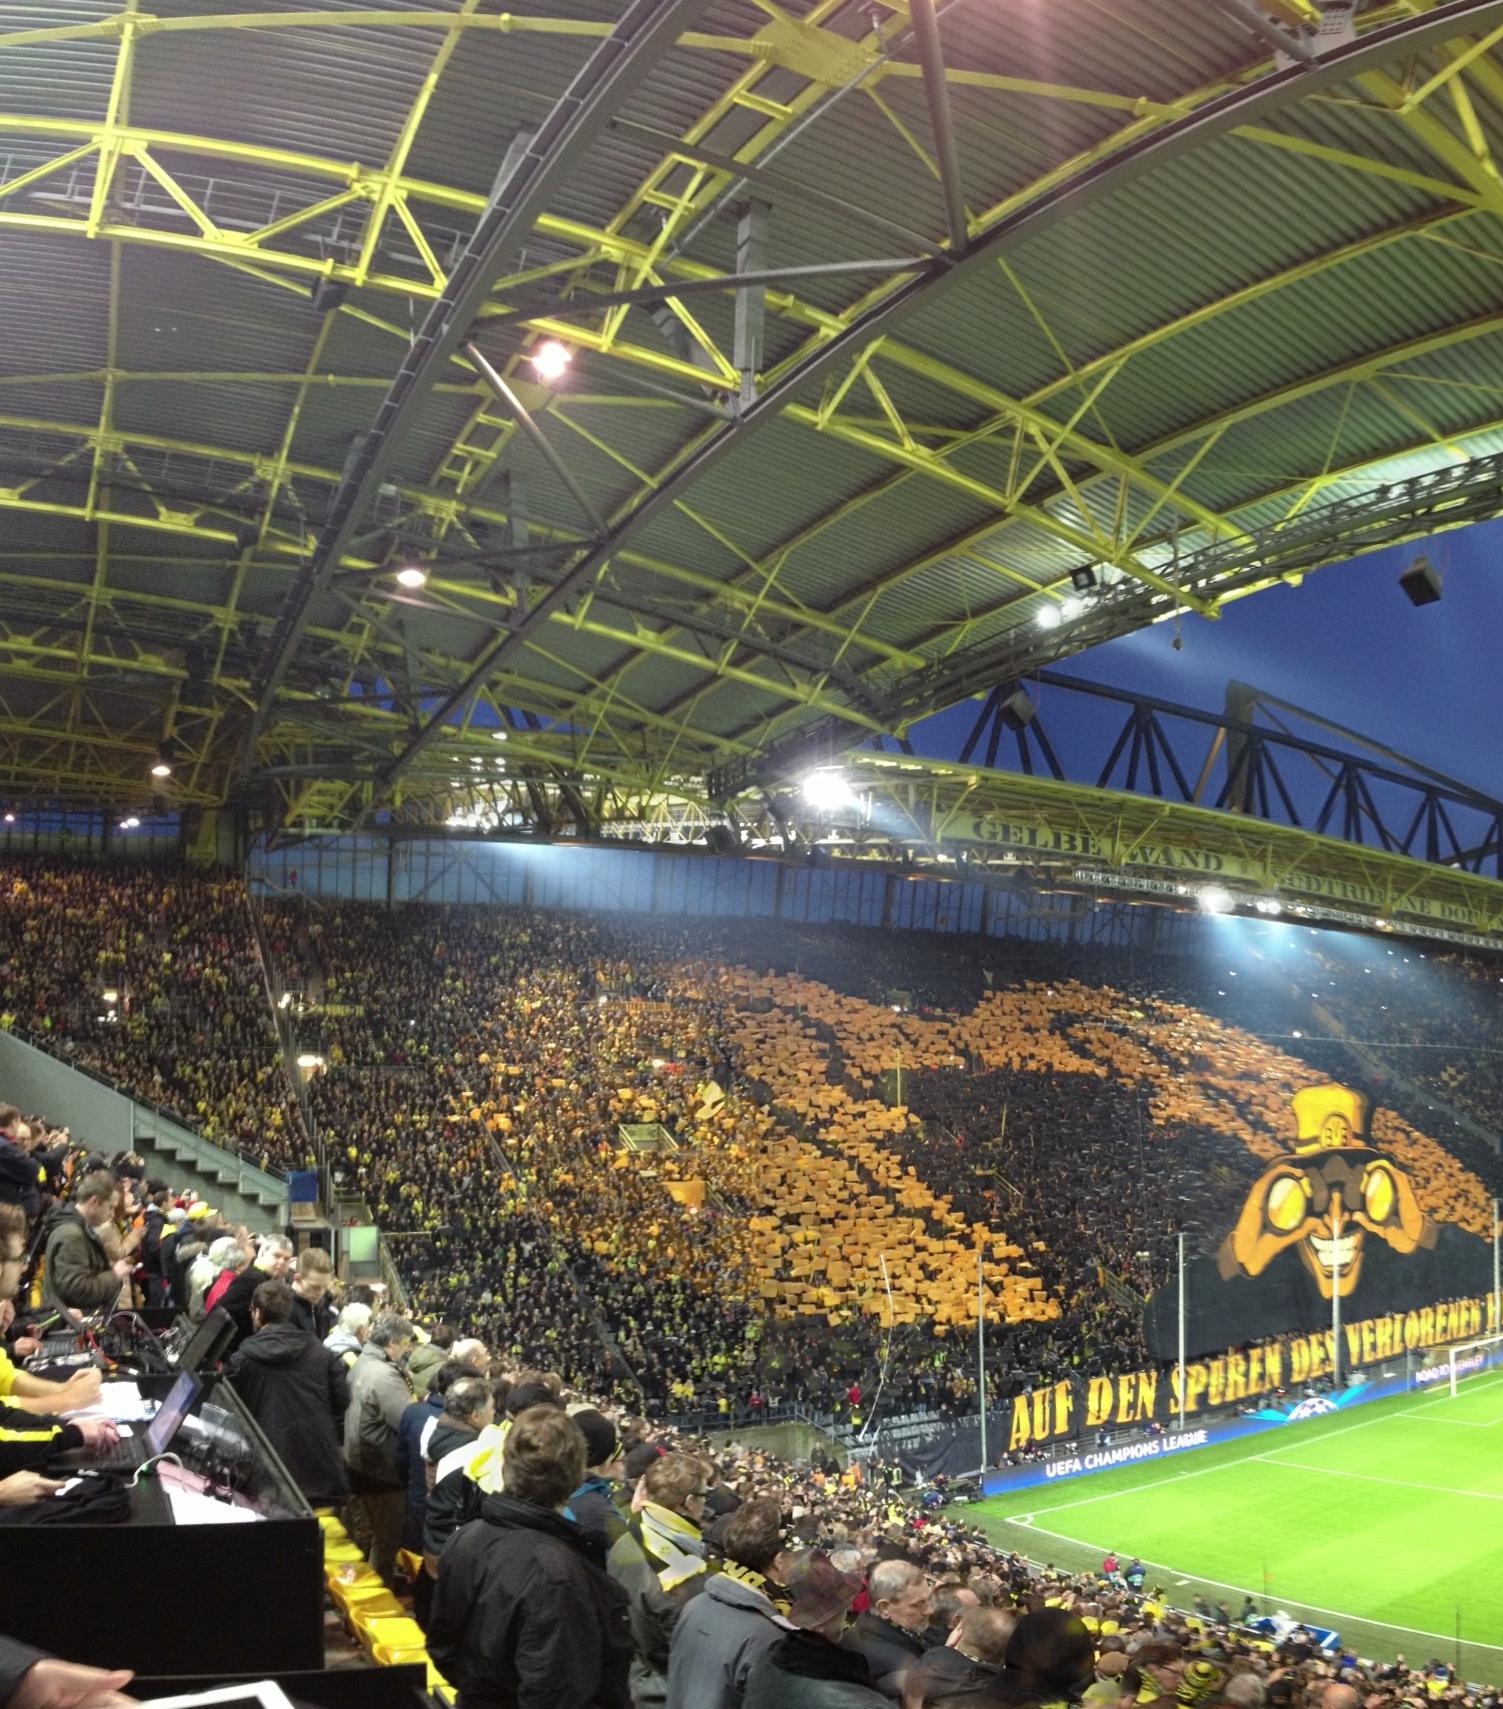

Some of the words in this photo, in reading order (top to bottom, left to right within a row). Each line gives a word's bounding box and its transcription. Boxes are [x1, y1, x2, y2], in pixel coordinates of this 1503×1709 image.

[971, 816, 1101, 856] GELBE
[1126, 841, 1225, 872] WAND
[1009, 1377, 1074, 1452] AUF
[1086, 1370, 1159, 1427] DEN
[1169, 1342, 1282, 1415] SPUREN
[1289, 1330, 1336, 1384] DES
[1343, 1298, 1481, 1367] VERLORENEN
[1045, 1458, 1083, 1478] UEFA
[1084, 1438, 1160, 1470] CHAMPIONS
